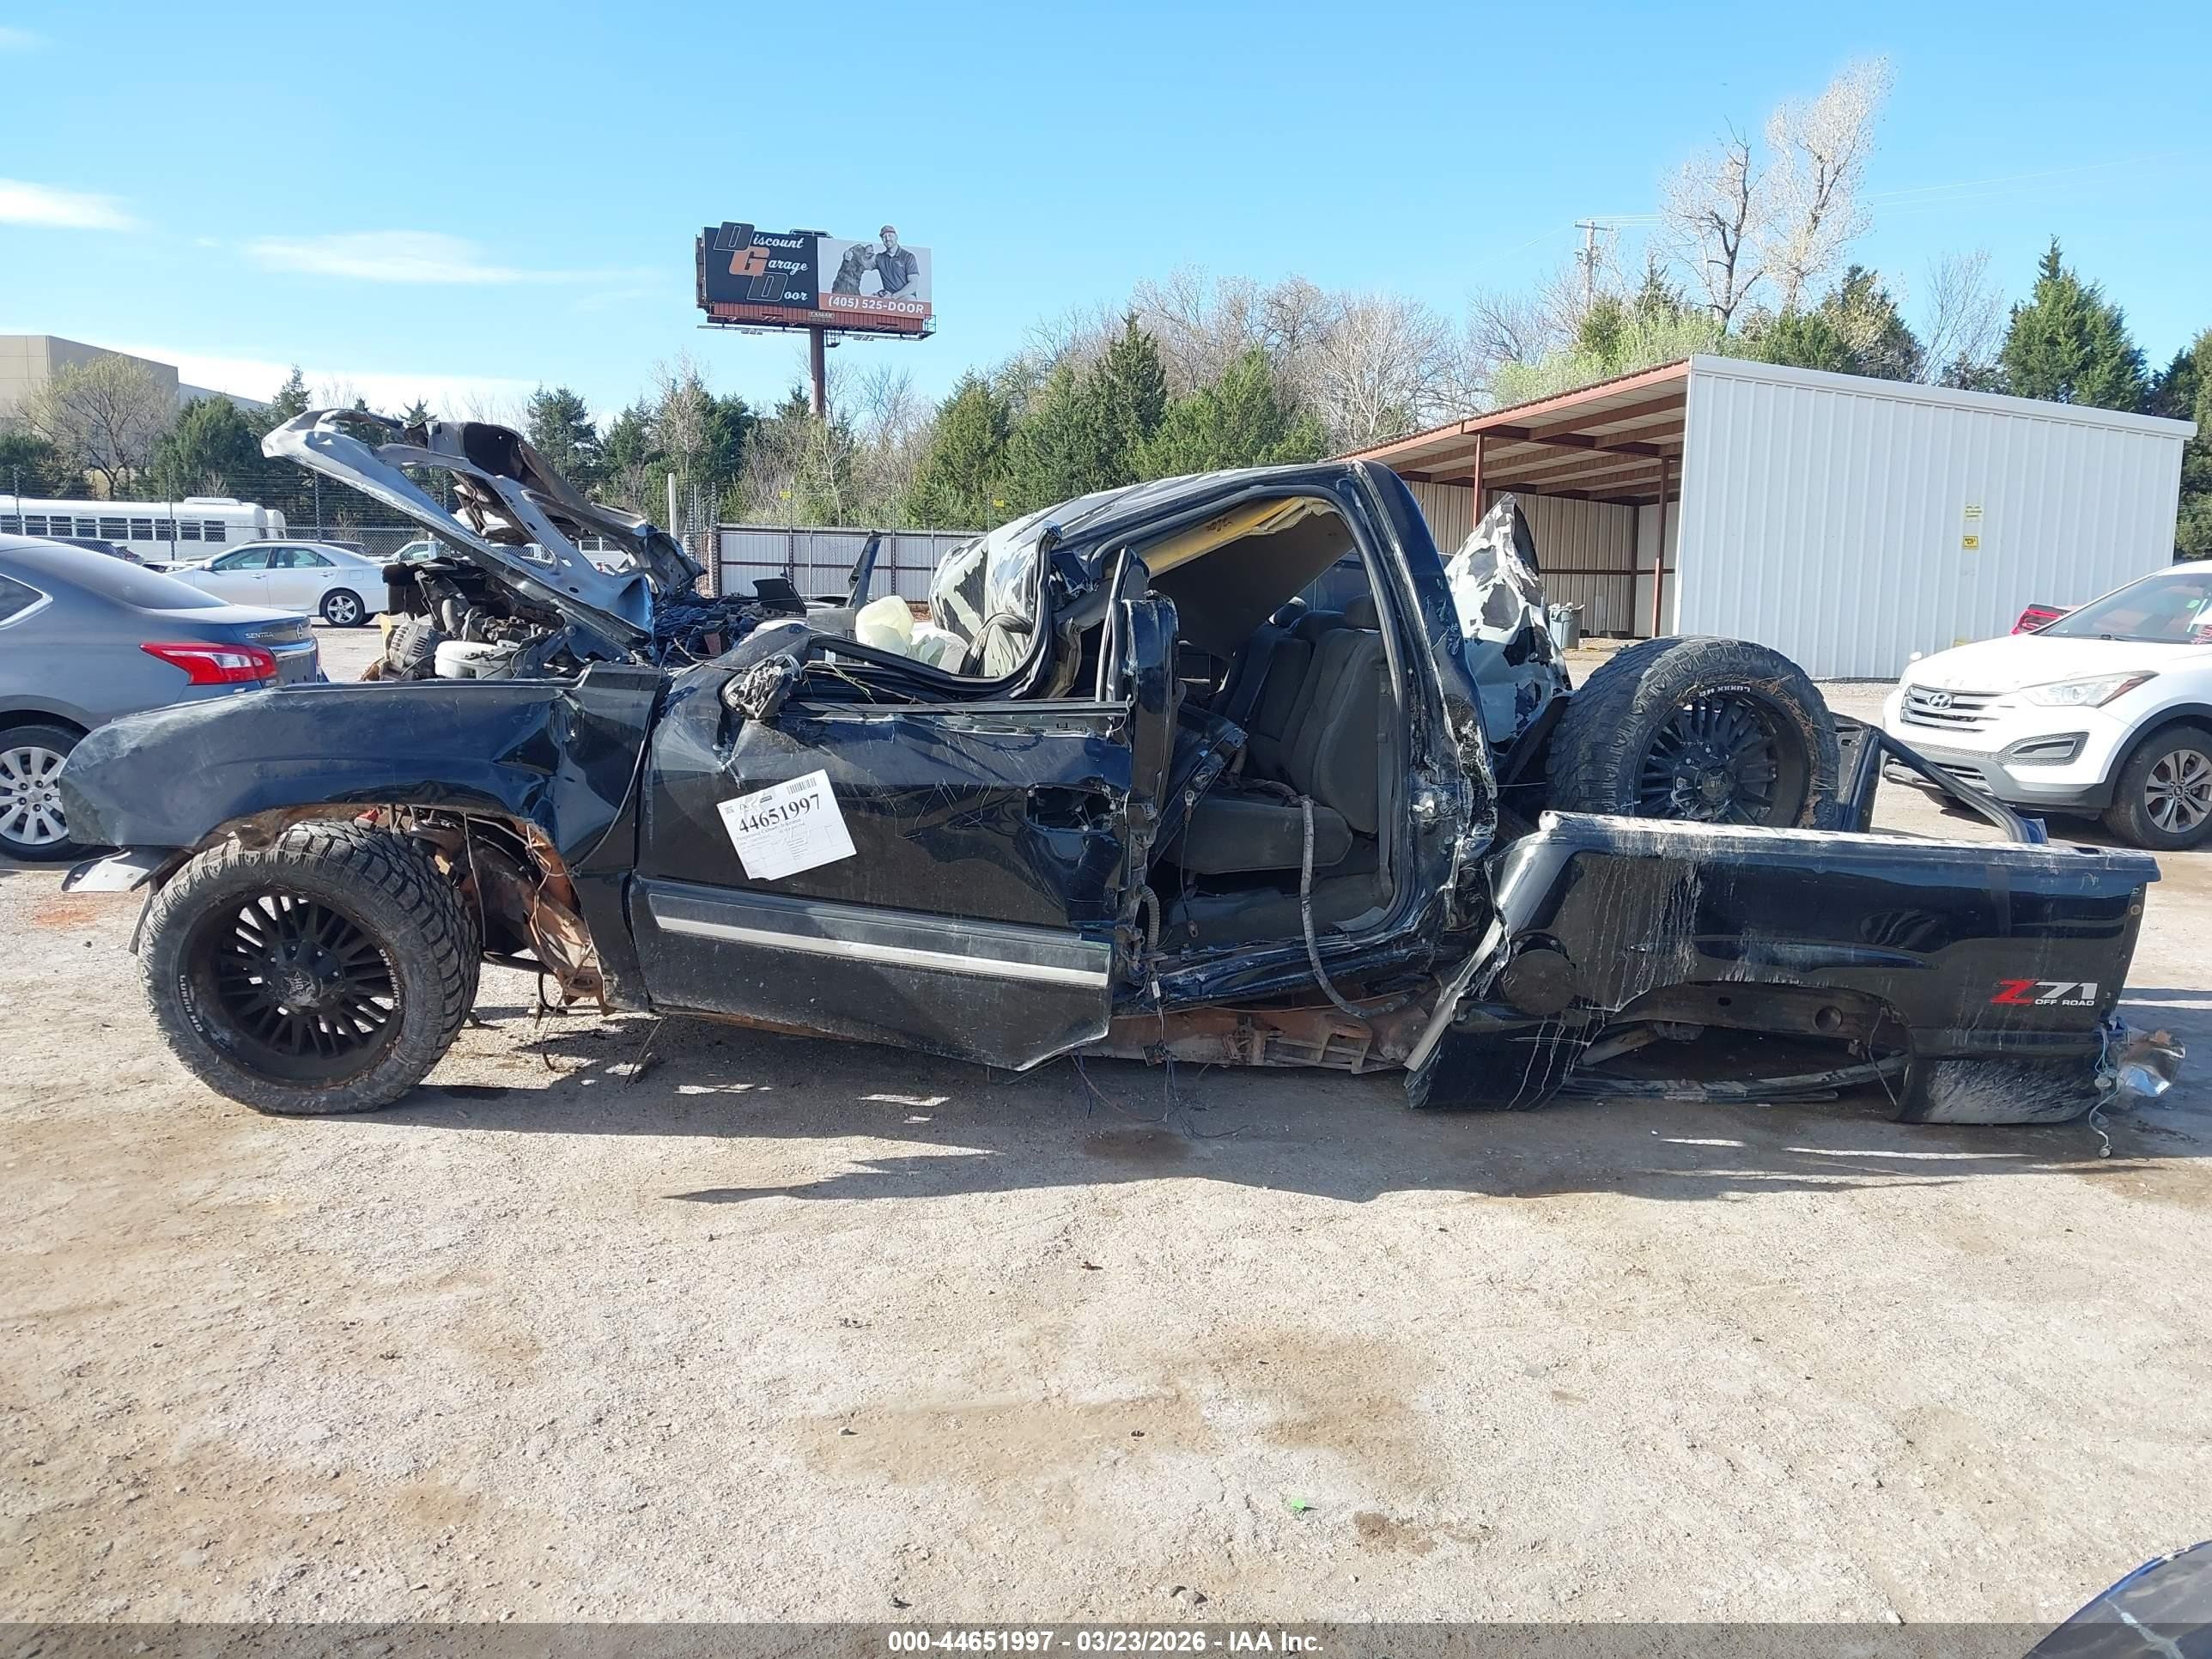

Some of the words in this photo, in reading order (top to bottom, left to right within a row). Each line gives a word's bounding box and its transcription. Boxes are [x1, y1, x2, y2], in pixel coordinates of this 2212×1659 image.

[714, 222, 804, 251] Discount
[729, 247, 809, 276] Garage
[747, 272, 808, 301] Door
[828, 295, 859, 310] (405)
[861, 298, 924, 314] 525-DOOR
[738, 793, 821, 834] 44651997
[1990, 979, 2098, 1004] Z71
